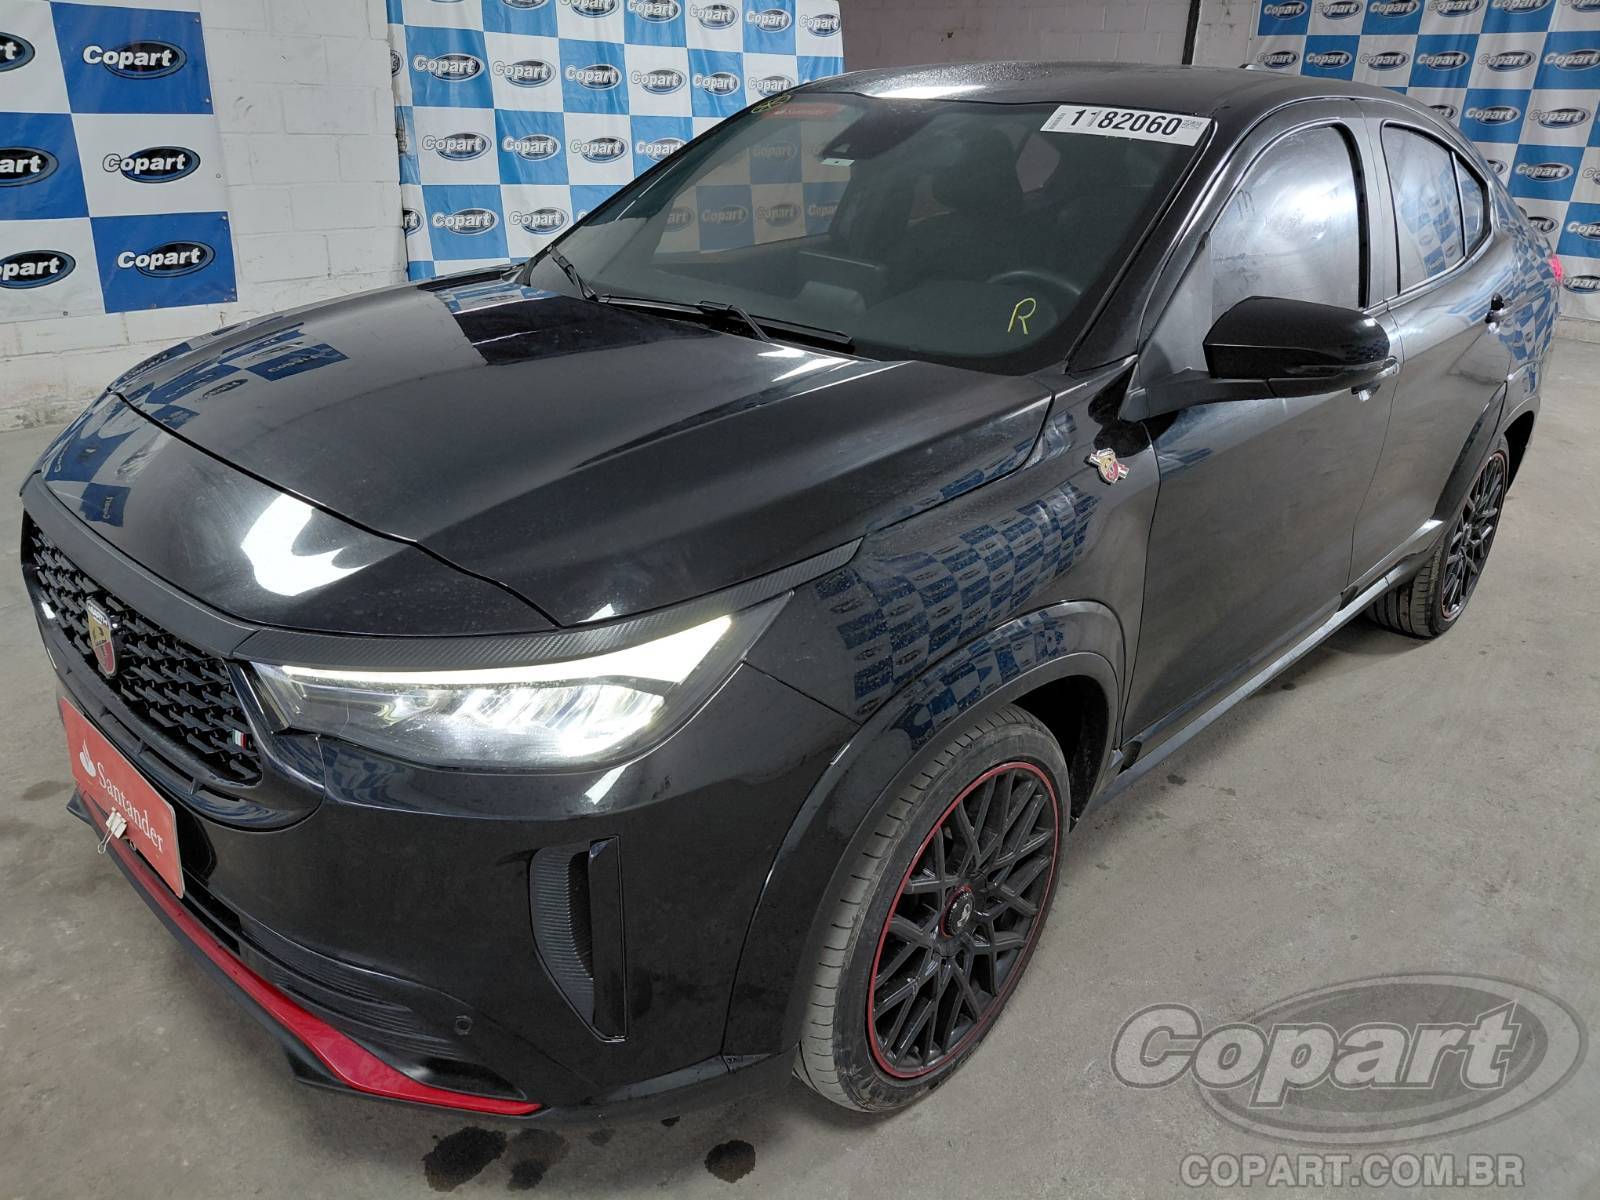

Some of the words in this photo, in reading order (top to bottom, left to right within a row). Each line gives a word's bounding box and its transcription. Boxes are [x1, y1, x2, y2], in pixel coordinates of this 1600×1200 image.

[627, 0, 675, 16] Copart
[690, 4, 732, 21] Copart
[1264, 3, 1302, 17] Copart
[1315, 1, 1356, 15] Copart
[1370, 0, 1415, 14] Copart
[746, 10, 787, 27] Copart
[799, 15, 840, 31] Copart
[83, 45, 173, 69] Copart
[413, 55, 477, 75] Copart
[1257, 51, 1295, 66] Copart
[1306, 51, 1347, 66] Copart
[1360, 52, 1404, 67] Copart
[1417, 52, 1465, 67] Copart
[1478, 53, 1528, 67] Copart
[1544, 52, 1600, 67] Copart
[493, 61, 548, 79] Copart
[565, 64, 617, 83] Copart
[631, 71, 679, 90] Copart
[693, 73, 736, 91] Copart
[749, 76, 791, 92] Copart
[1070, 109, 1183, 136] 1182060
[1466, 107, 1516, 122] Copart
[1529, 108, 1584, 124] Copart
[422, 134, 483, 155] Copart
[503, 136, 553, 155] Copart
[570, 139, 621, 157] Copart
[103, 153, 186, 175] Copart
[1516, 162, 1565, 178] Copart
[432, 208, 490, 229] Copart
[509, 209, 561, 228] Copart
[702, 208, 744, 225] Copart
[117, 247, 200, 271] Copart
[1008, 297, 1036, 335] R
[97, 761, 164, 853] Santander
